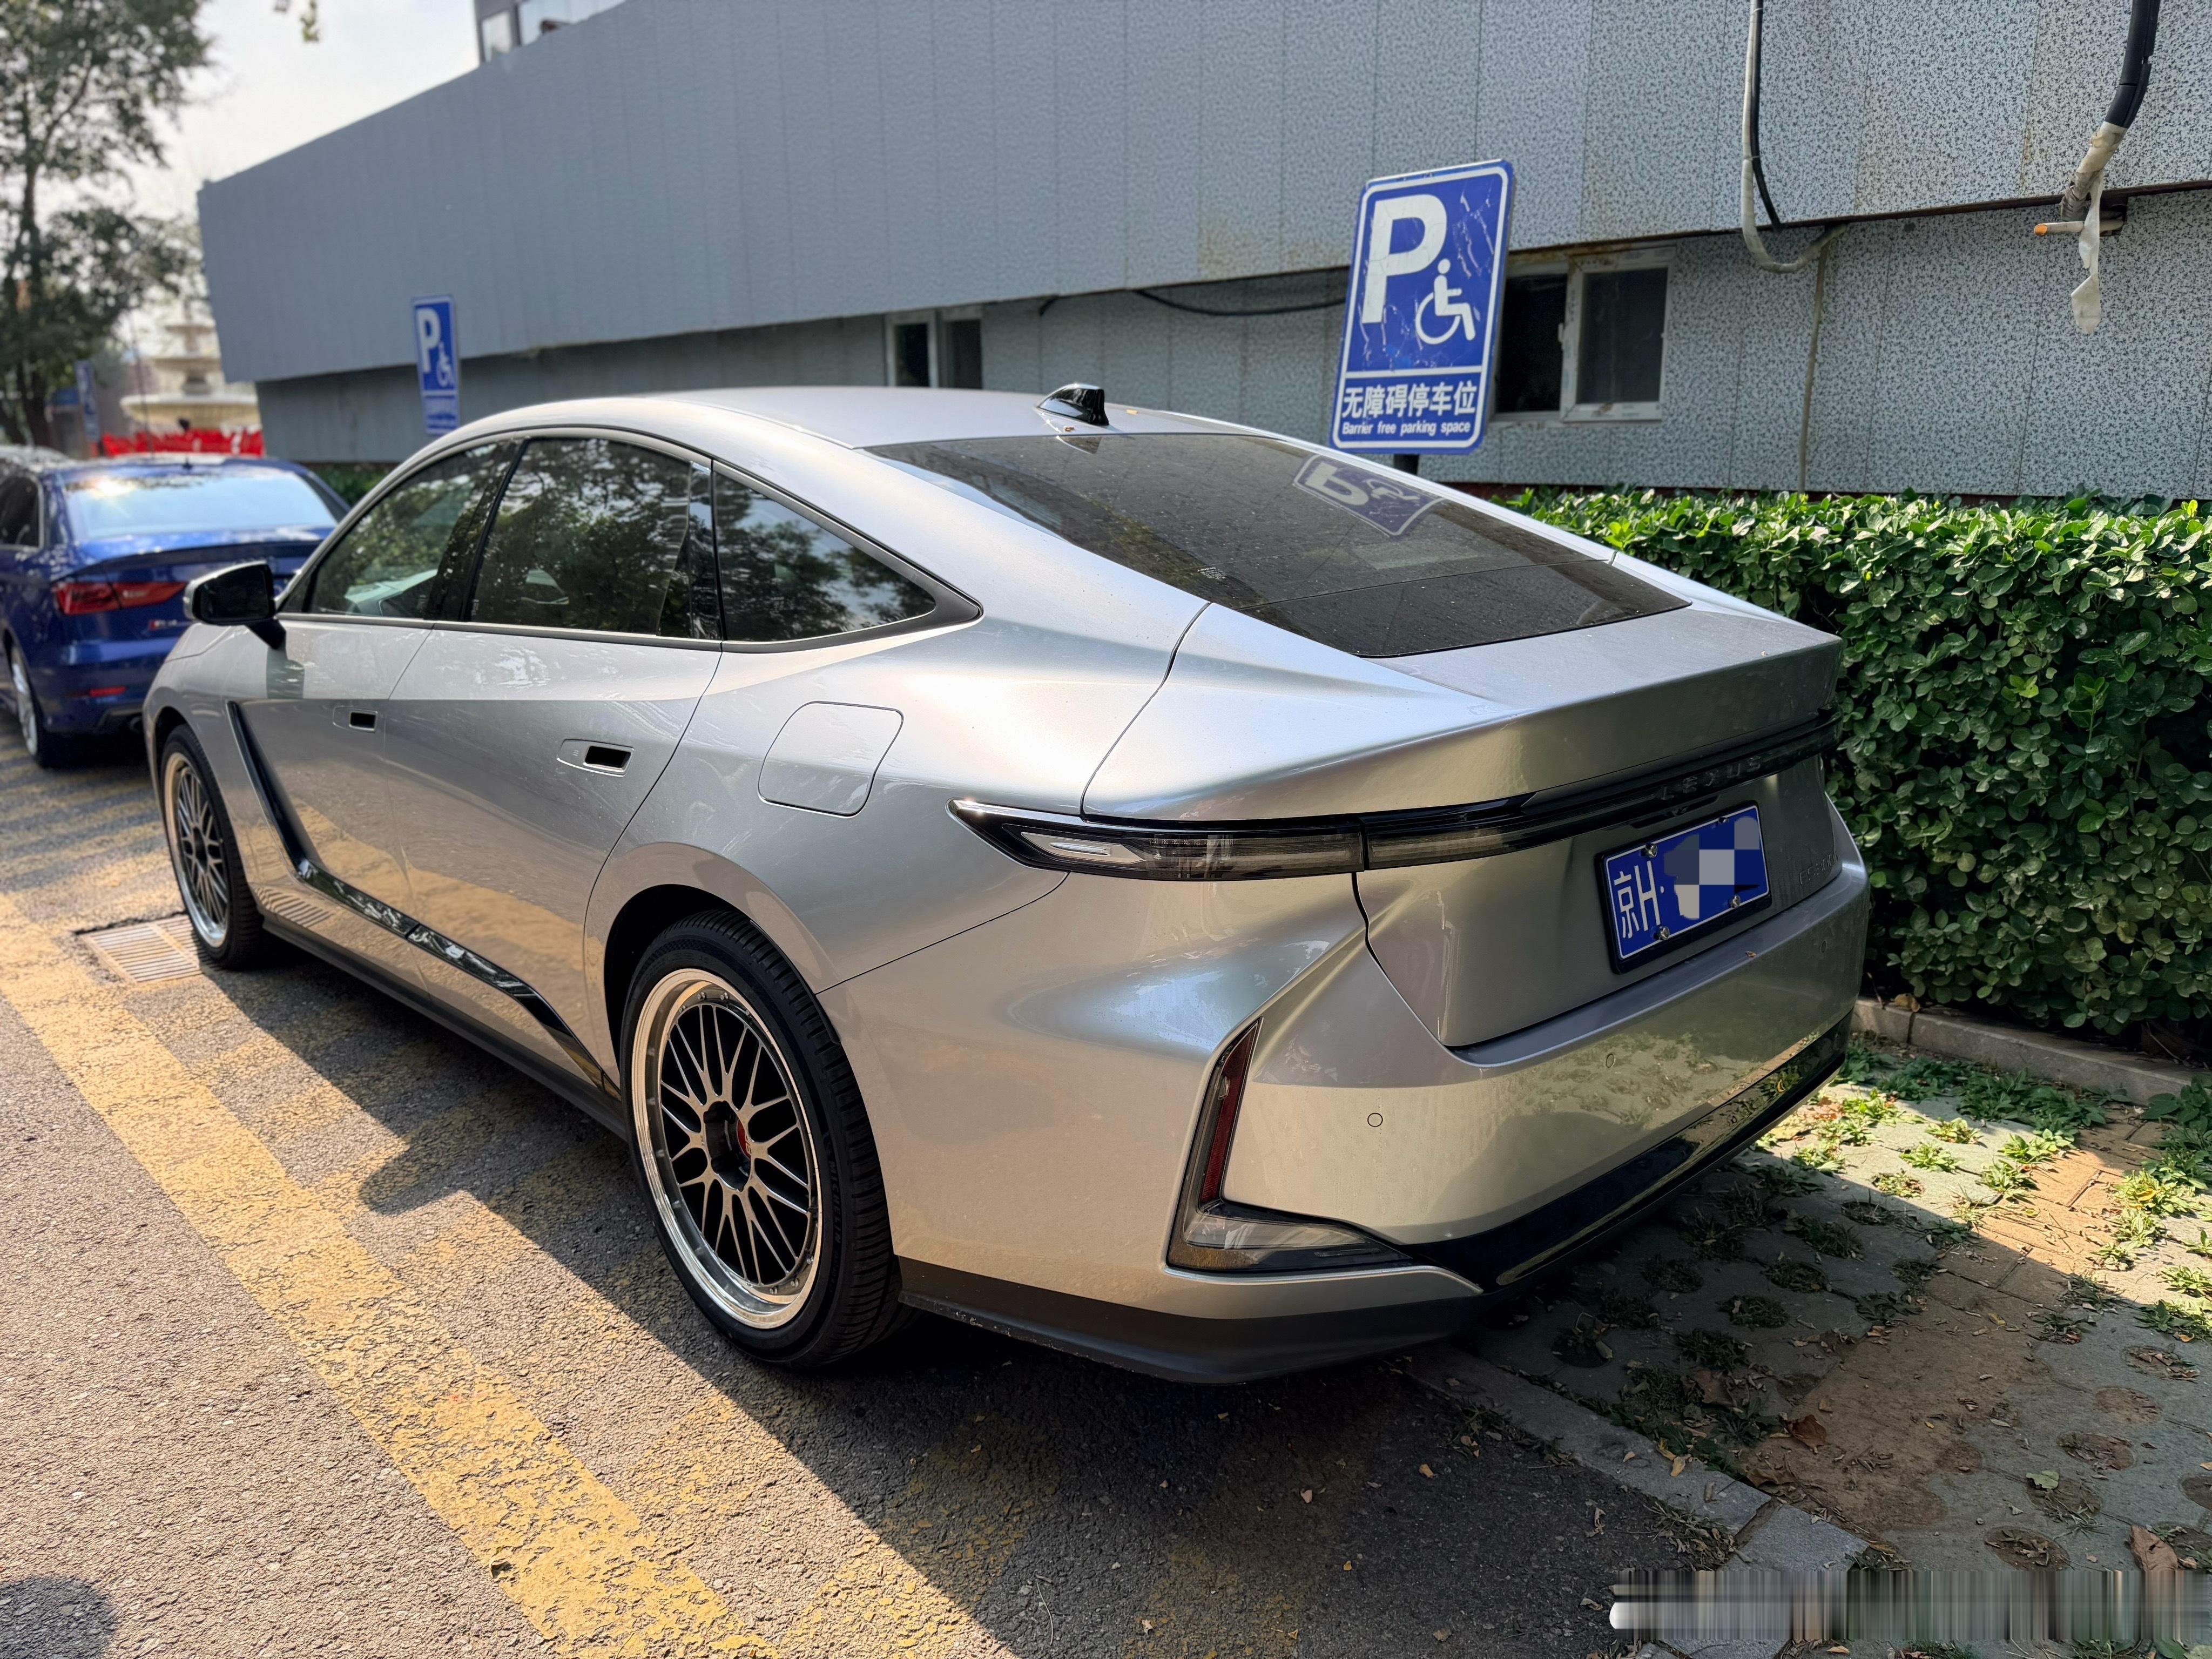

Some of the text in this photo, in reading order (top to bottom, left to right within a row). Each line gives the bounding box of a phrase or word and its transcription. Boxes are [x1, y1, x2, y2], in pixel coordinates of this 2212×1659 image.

[1361, 194, 1447, 324] P
[416, 307, 441, 373] P
[1341, 380, 1478, 419] 无障碍停车位
[1342, 420, 1471, 437] Barrier free parking space
[829, 1161, 842, 1244] MICHELIN
